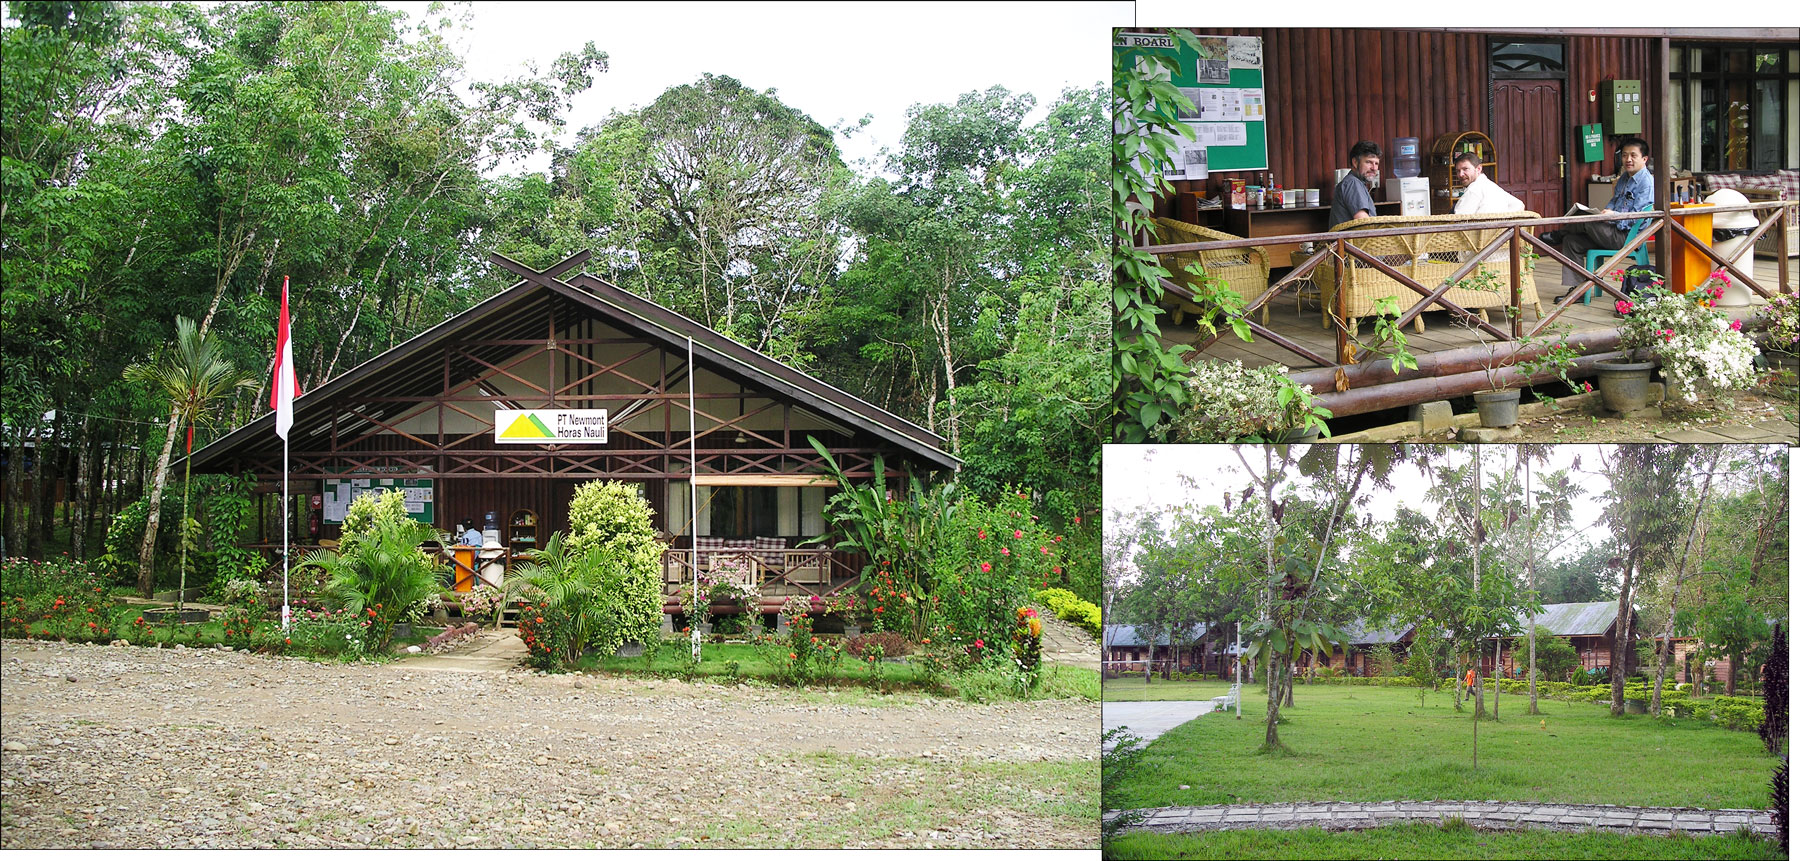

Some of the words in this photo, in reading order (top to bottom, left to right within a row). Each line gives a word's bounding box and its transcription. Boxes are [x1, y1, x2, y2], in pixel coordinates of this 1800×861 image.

[557, 414, 567, 425] PT
[569, 414, 604, 425] Newmont
[557, 426, 581, 438] Horas
[584, 426, 604, 437] Nauli
